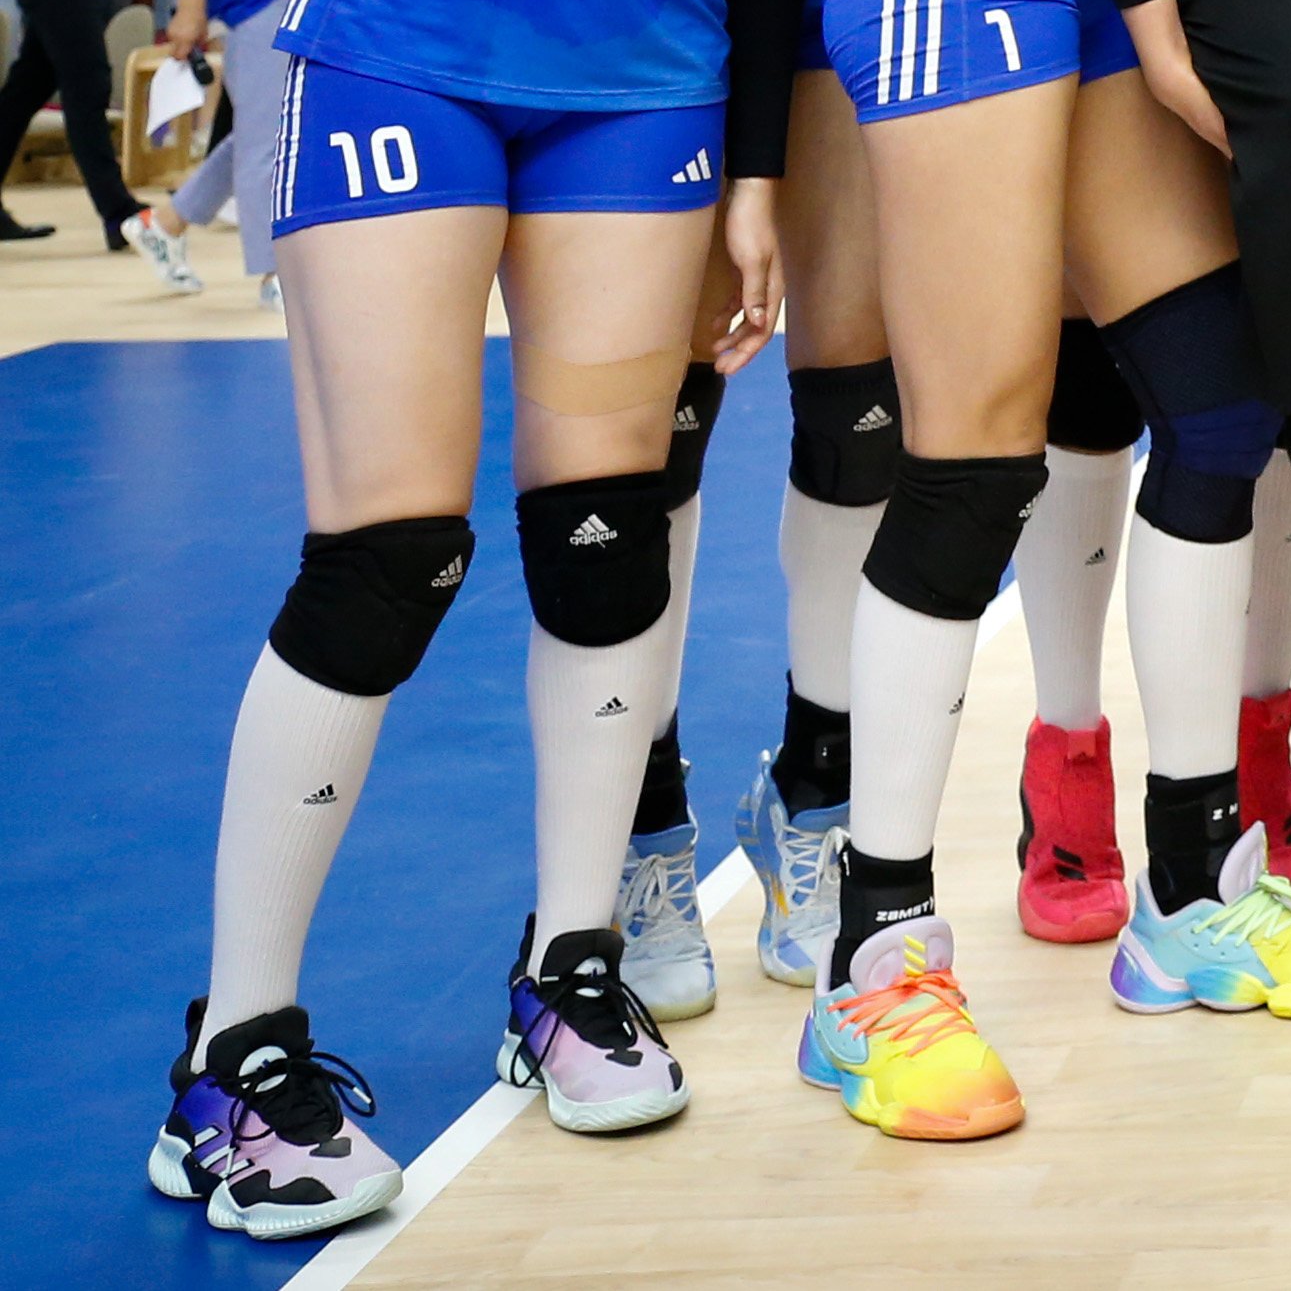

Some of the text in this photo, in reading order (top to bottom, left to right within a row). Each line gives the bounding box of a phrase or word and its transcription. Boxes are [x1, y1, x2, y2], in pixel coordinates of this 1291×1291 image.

[983, 8, 1022, 72] 1
[329, 124, 419, 199] 10
[570, 529, 618, 547] adidas
